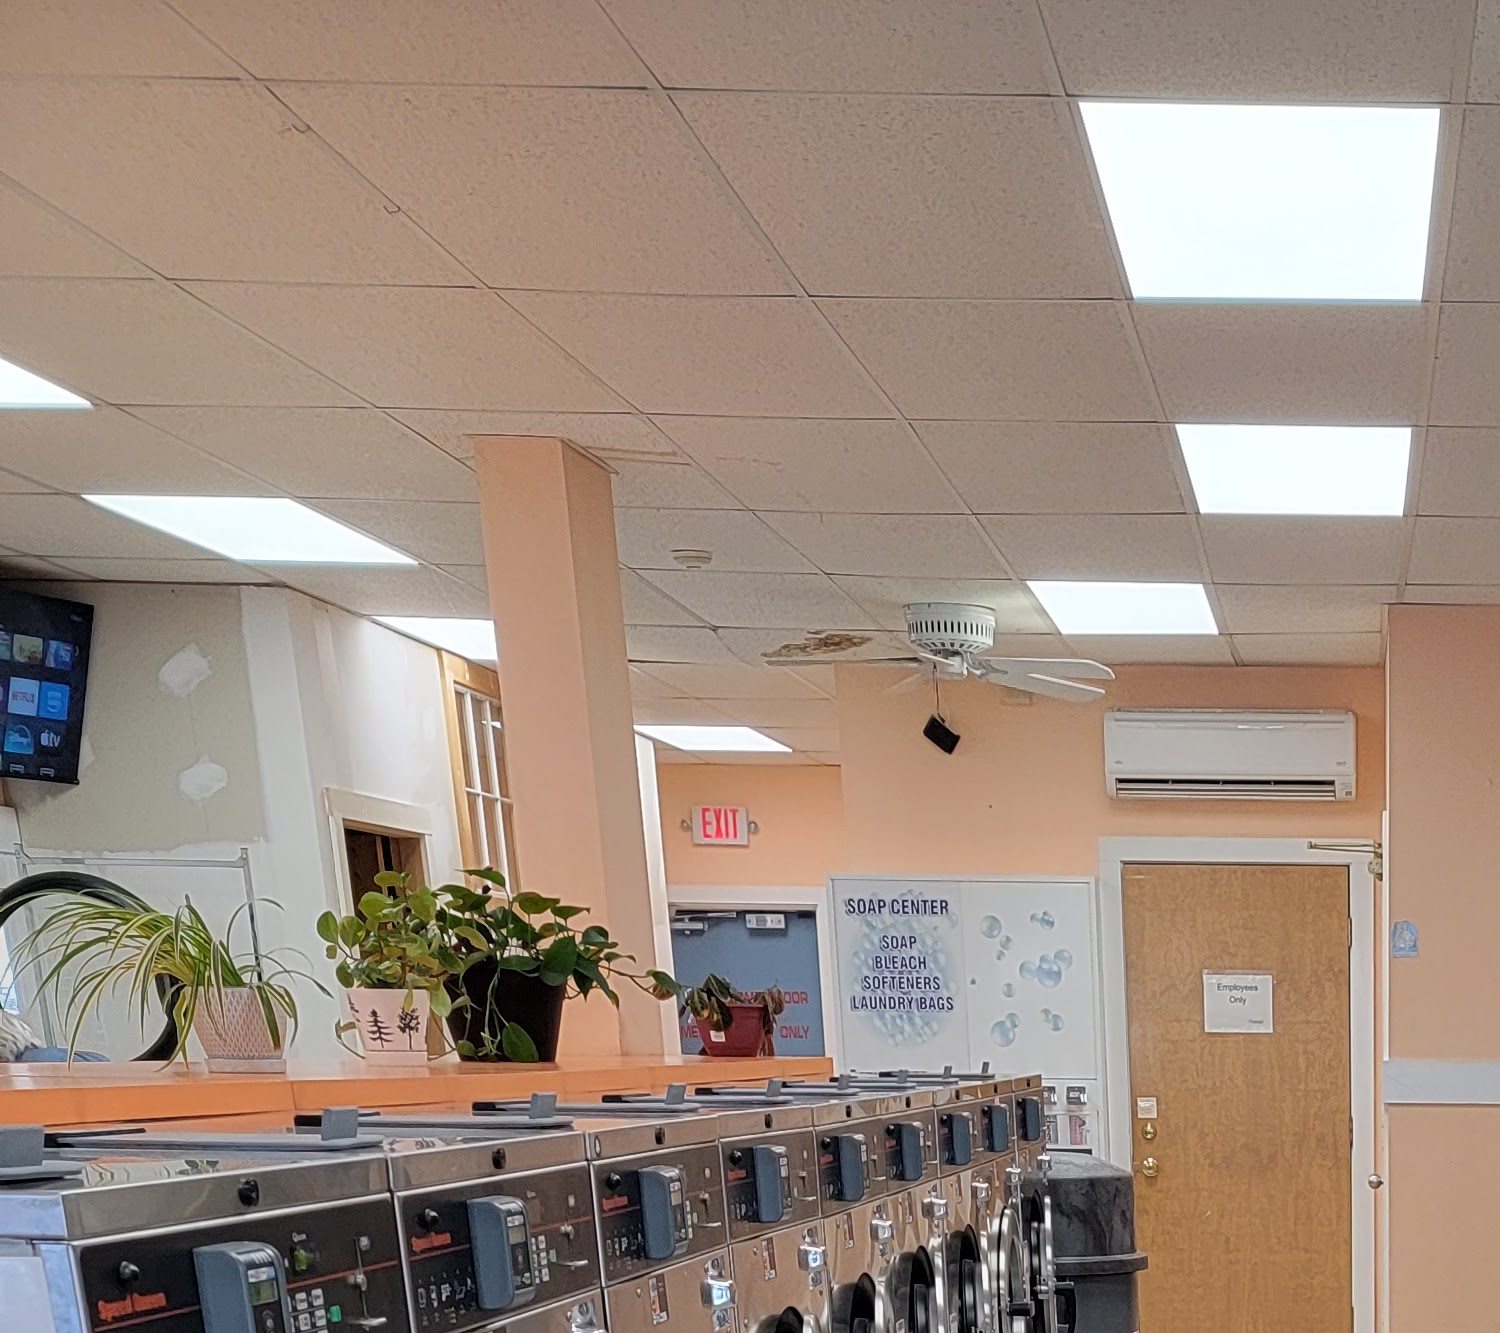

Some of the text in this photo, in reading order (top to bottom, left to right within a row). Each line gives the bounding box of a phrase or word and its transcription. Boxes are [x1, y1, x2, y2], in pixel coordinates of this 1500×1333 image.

[701, 807, 738, 839] EXIT
[846, 898, 949, 916] SOAP CENTER
[881, 934, 917, 950] SOAP
[873, 955, 927, 970] BLEACH
[862, 975, 941, 991] SOFTENERS
[1216, 982, 1259, 993] Employees
[851, 995, 954, 1011] LAUNDRY BAGS
[1228, 995, 1247, 1006] Only
[780, 1026, 809, 1039] ONLY
